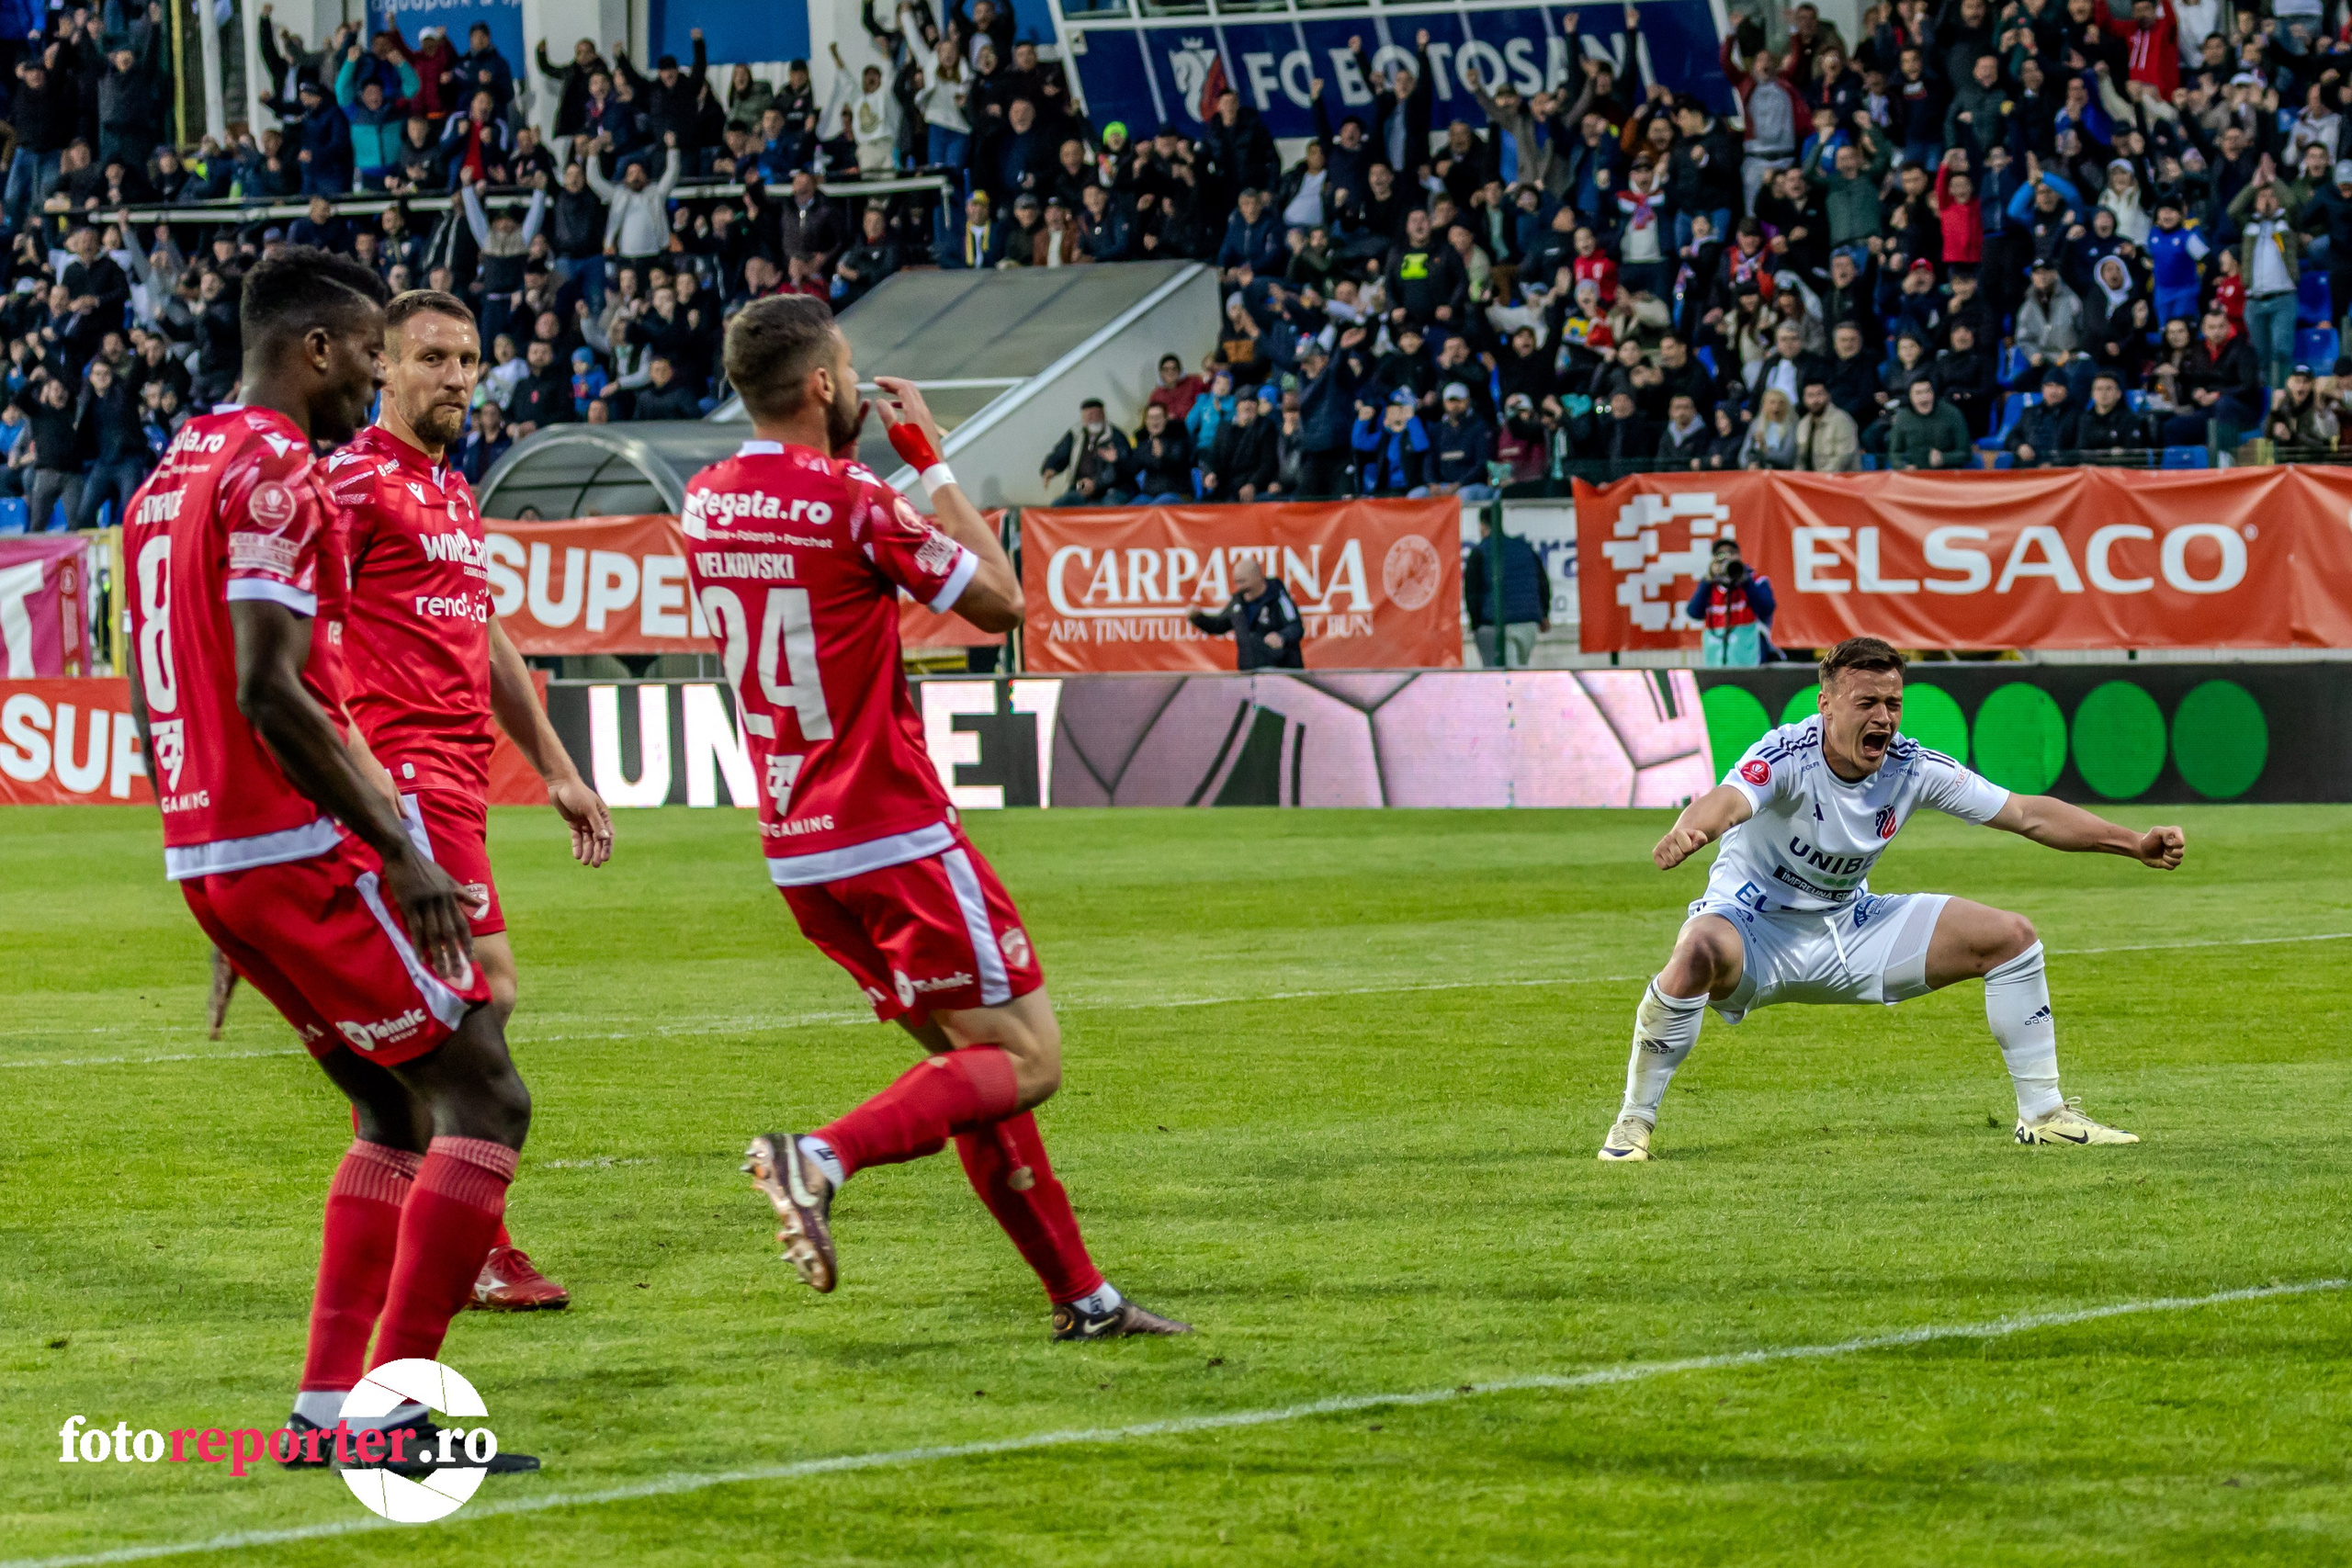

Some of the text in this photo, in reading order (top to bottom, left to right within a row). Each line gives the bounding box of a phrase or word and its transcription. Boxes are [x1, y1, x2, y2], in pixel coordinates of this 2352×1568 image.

[1243, 51, 1312, 110] FC
[695, 487, 833, 526] Regata.ro
[695, 552, 795, 580] VELKOVSKI
[1792, 524, 2248, 594] ELSACO
[137, 536, 177, 714] 8
[1048, 618, 1089, 642] APA
[1327, 614, 1374, 638] BUN
[700, 586, 833, 741] 24
[769, 815, 834, 839] GAMING
[1789, 836, 1882, 875] UNIBE
